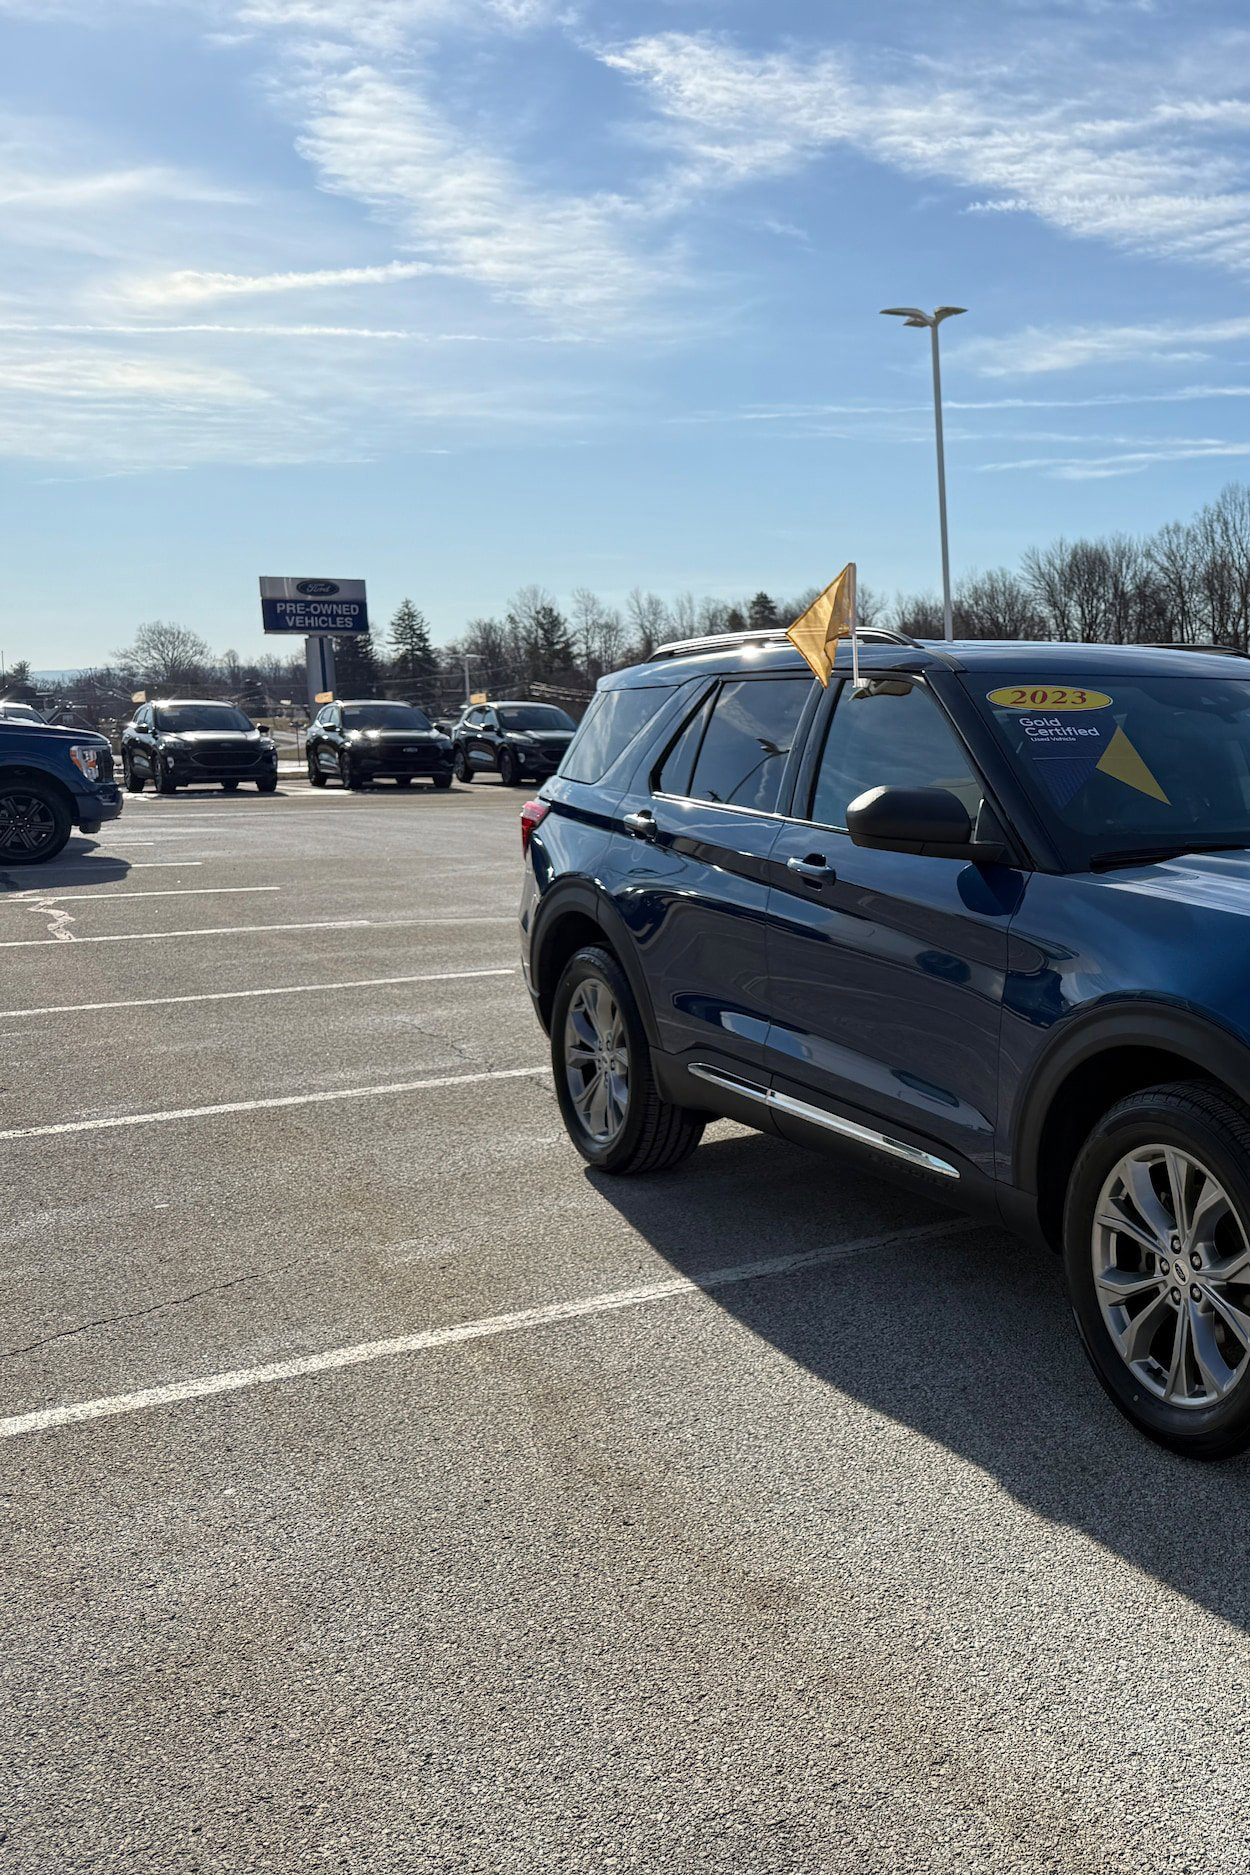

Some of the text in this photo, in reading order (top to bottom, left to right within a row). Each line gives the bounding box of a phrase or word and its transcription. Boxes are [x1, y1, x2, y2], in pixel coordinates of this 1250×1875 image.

[276, 602, 360, 616] PRE-OWNED
[285, 616, 354, 628] VEHICLES
[1010, 689, 1087, 705] 2023
[1019, 717, 1062, 727] Gold
[1025, 727, 1100, 737] Certified
